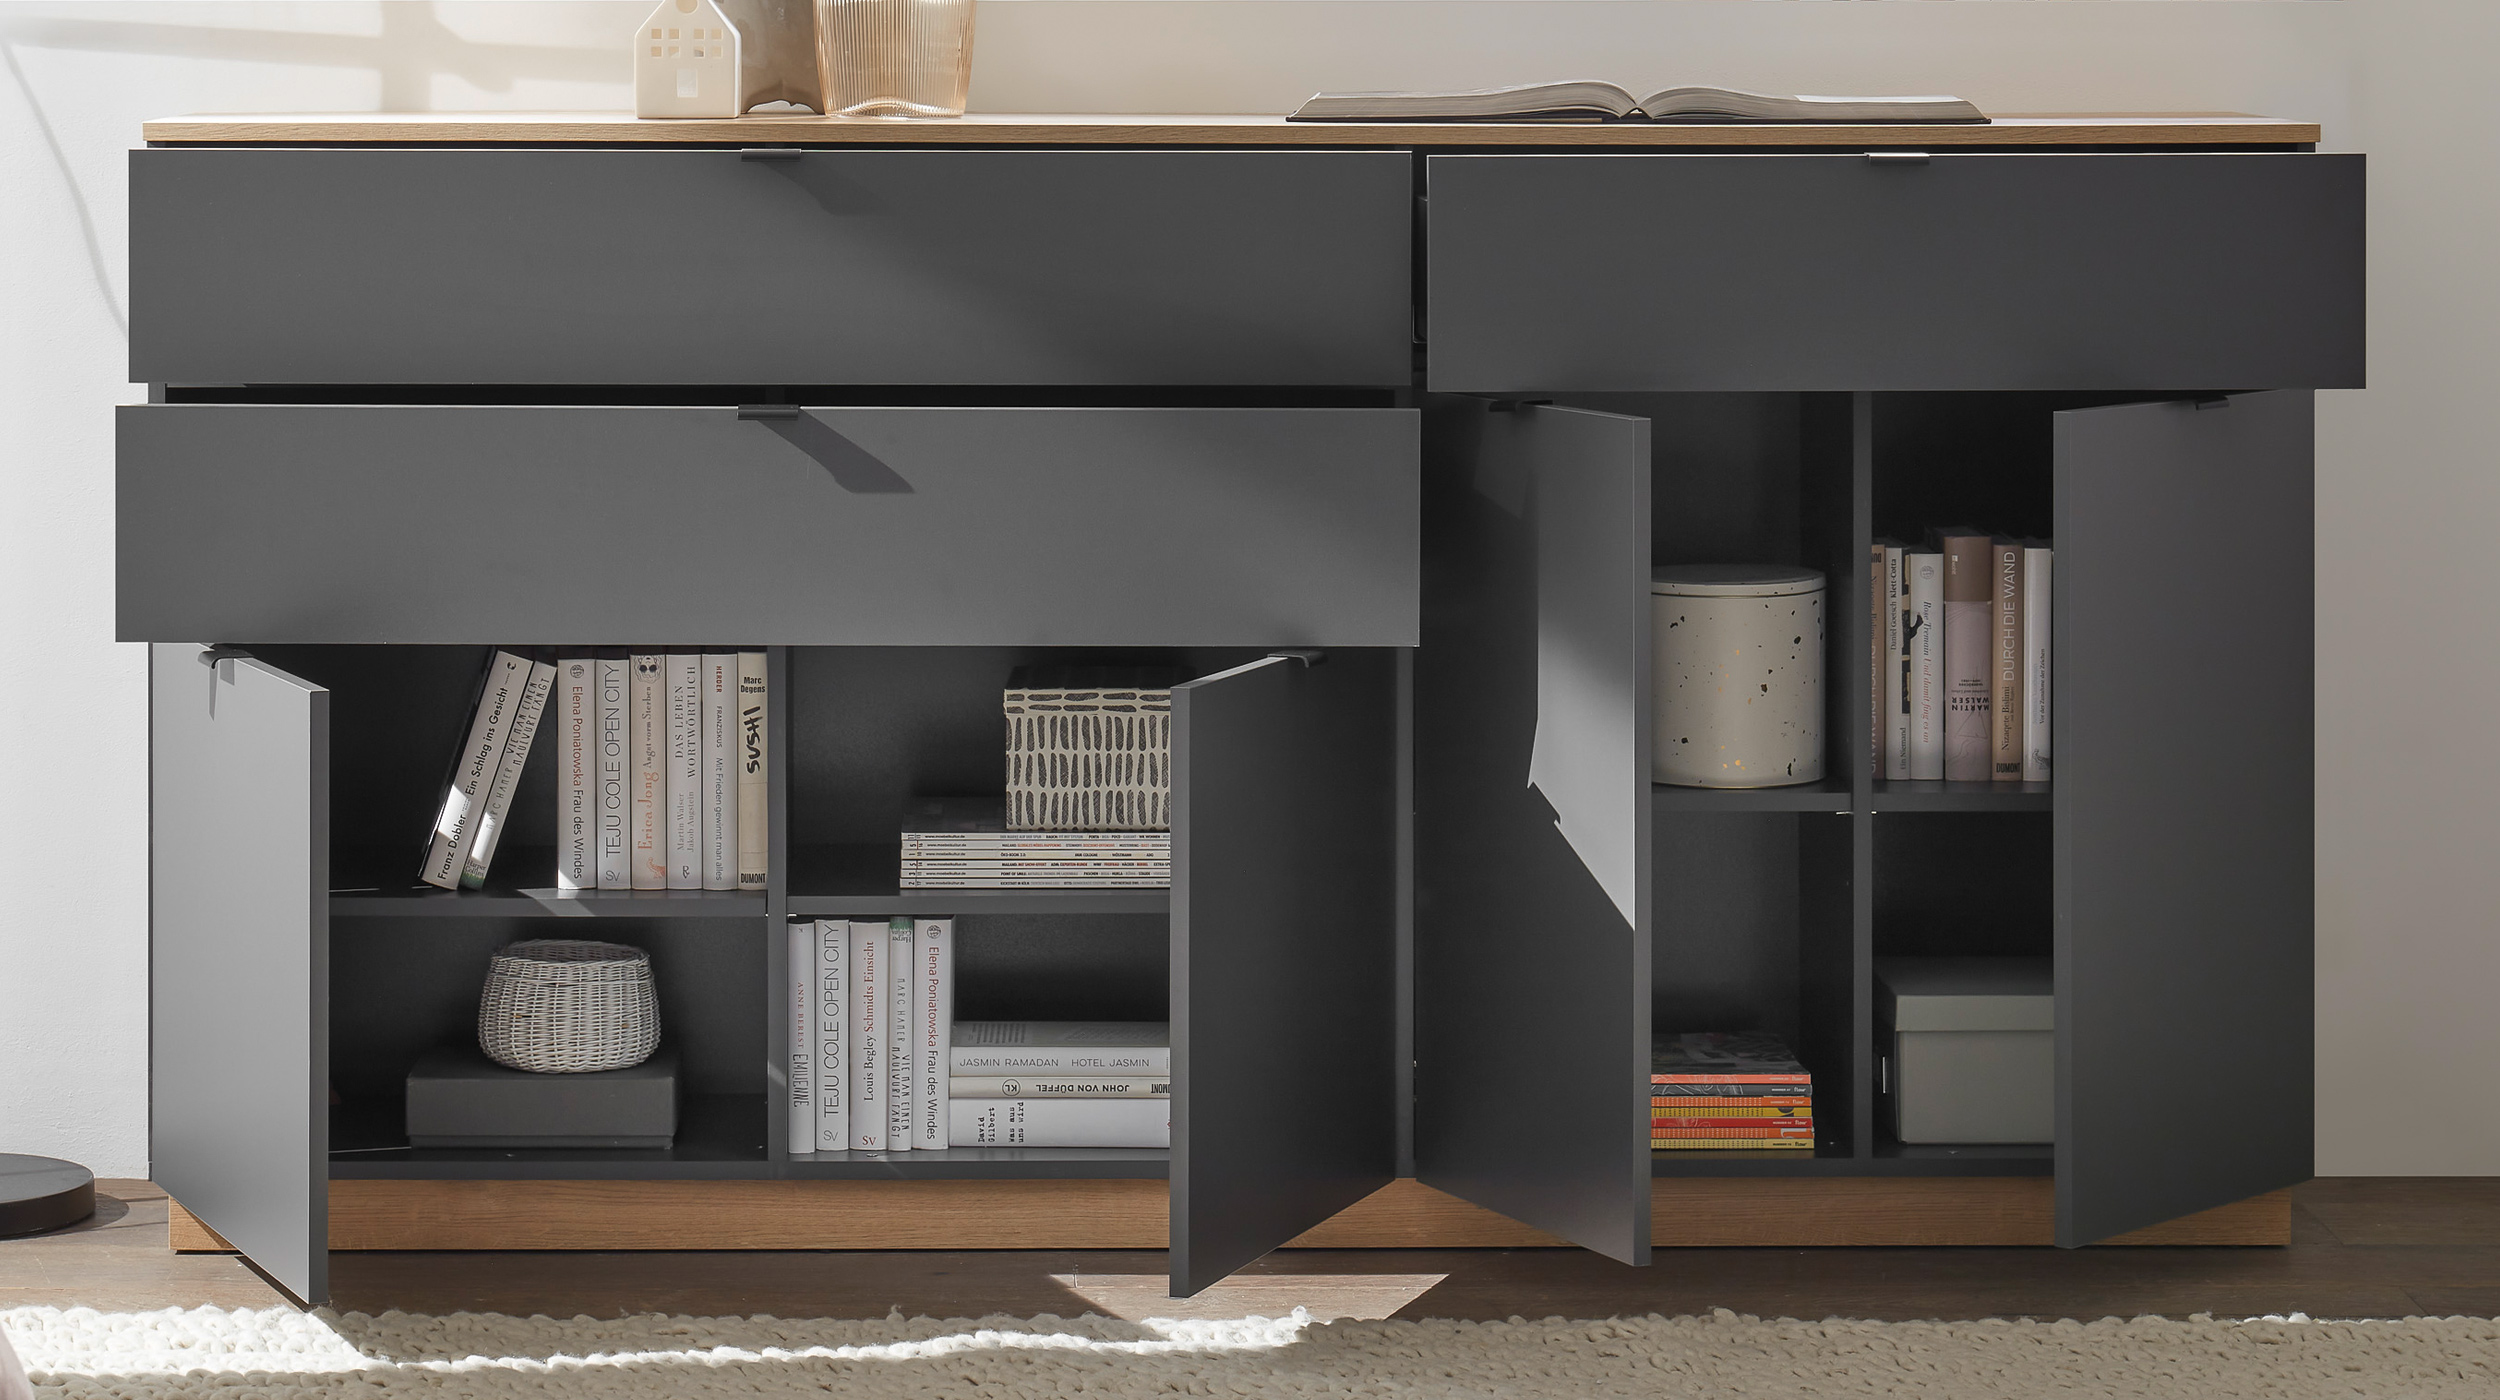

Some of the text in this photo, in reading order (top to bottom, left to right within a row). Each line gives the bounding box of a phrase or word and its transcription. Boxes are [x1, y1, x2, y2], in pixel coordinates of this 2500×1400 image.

[1923, 601, 1932, 620] Rose
[2003, 552, 2016, 681] DURCH DIE WAND
[1923, 622, 1932, 656] Tremain
[605, 664, 621, 703] CITY
[1923, 658, 1932, 676] Und
[488, 687, 508, 726] Gesicht
[642, 686, 652, 720] Sterben
[740, 685, 766, 694] Degens
[1923, 678, 1932, 702] damit
[482, 728, 495, 742] ins
[605, 707, 621, 757] OPEN
[674, 685, 684, 758] DAS LEBEN
[686, 666, 696, 778] WORTWÖRTLICH
[2001, 686, 2011, 750] Nizaqete Bislimi
[642, 743, 656, 769] Angst
[742, 706, 763, 774] SUSHI
[1923, 732, 1932, 743] an
[471, 740, 491, 779] Schlag
[1996, 763, 2020, 774] DUMONT
[465, 780, 478, 796] Ein
[572, 686, 584, 879] Elena Poniatowska Frau des Windes
[605, 761, 621, 810] COLE
[638, 772, 660, 808] Jong
[448, 814, 467, 850] Dobler
[605, 815, 621, 858] TEJU
[638, 812, 652, 850] Erica
[676, 792, 684, 851] Martin Walser
[686, 792, 696, 853] Jakob Augstein
[714, 806, 723, 840] gewinnt
[438, 851, 454, 880] Franz
[740, 872, 766, 884] DUMONT
[824, 924, 840, 964] CITY
[824, 967, 840, 1017] OPEN
[863, 941, 876, 1102] Louis Begley Schmidts Einsicht
[824, 1021, 840, 1070] COLE
[927, 947, 940, 1140] Elena Poniatowska Frau des Windes
[960, 1058, 1150, 1067] JASMIN RAMADAN HOTEL JASMIN
[792, 1053, 809, 1108] EMILIENNE
[824, 1075, 840, 1118] TEJU
[1004, 1084, 1018, 1092] KL
[1036, 1084, 1170, 1094] MONT JOHN VON DÜFFEL
[862, 1136, 877, 1146] SV
[988, 1107, 996, 1143] Gilbert
